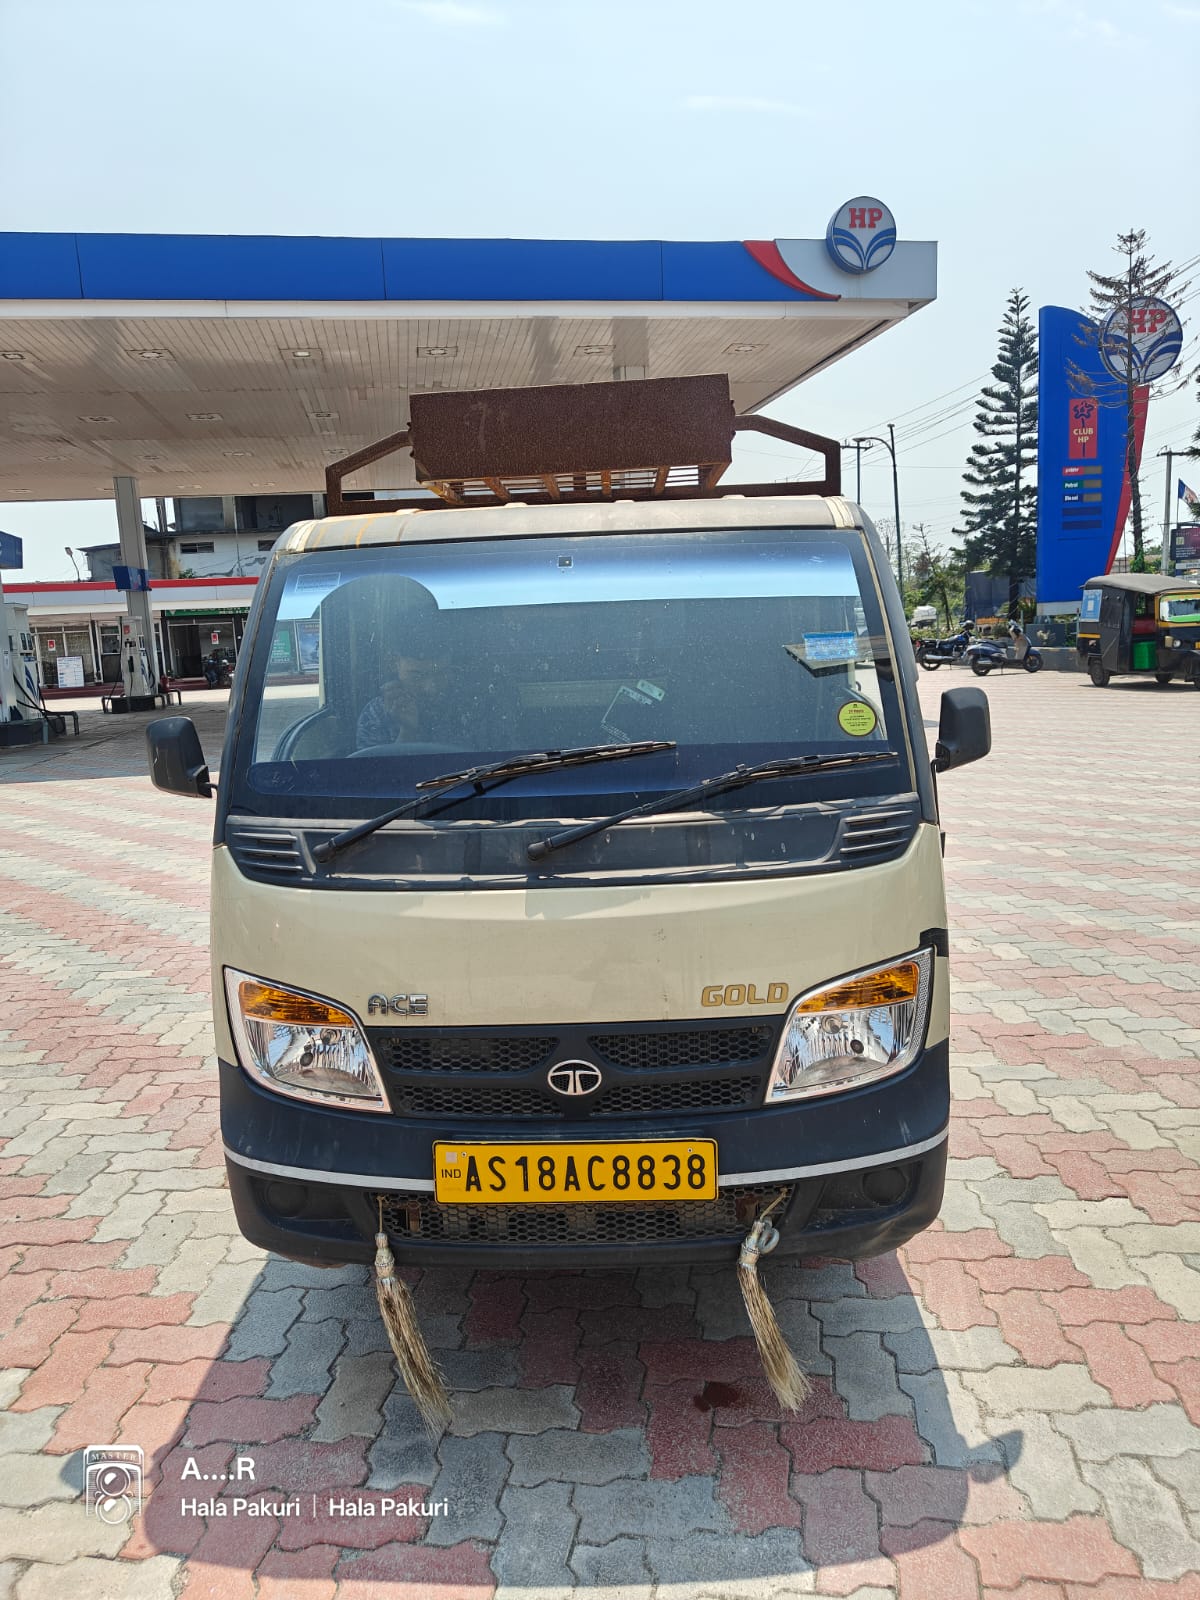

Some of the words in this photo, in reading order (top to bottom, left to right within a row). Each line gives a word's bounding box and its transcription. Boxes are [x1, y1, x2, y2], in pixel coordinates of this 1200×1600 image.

[848, 207, 883, 229] HP
[1125, 308, 1167, 333] HP
[1073, 427, 1094, 435] CLUB
[367, 992, 429, 1017] ACE
[701, 982, 789, 1008] GOLD
[441, 1168, 462, 1180] IND
[465, 1153, 706, 1192] AS18AC8838
